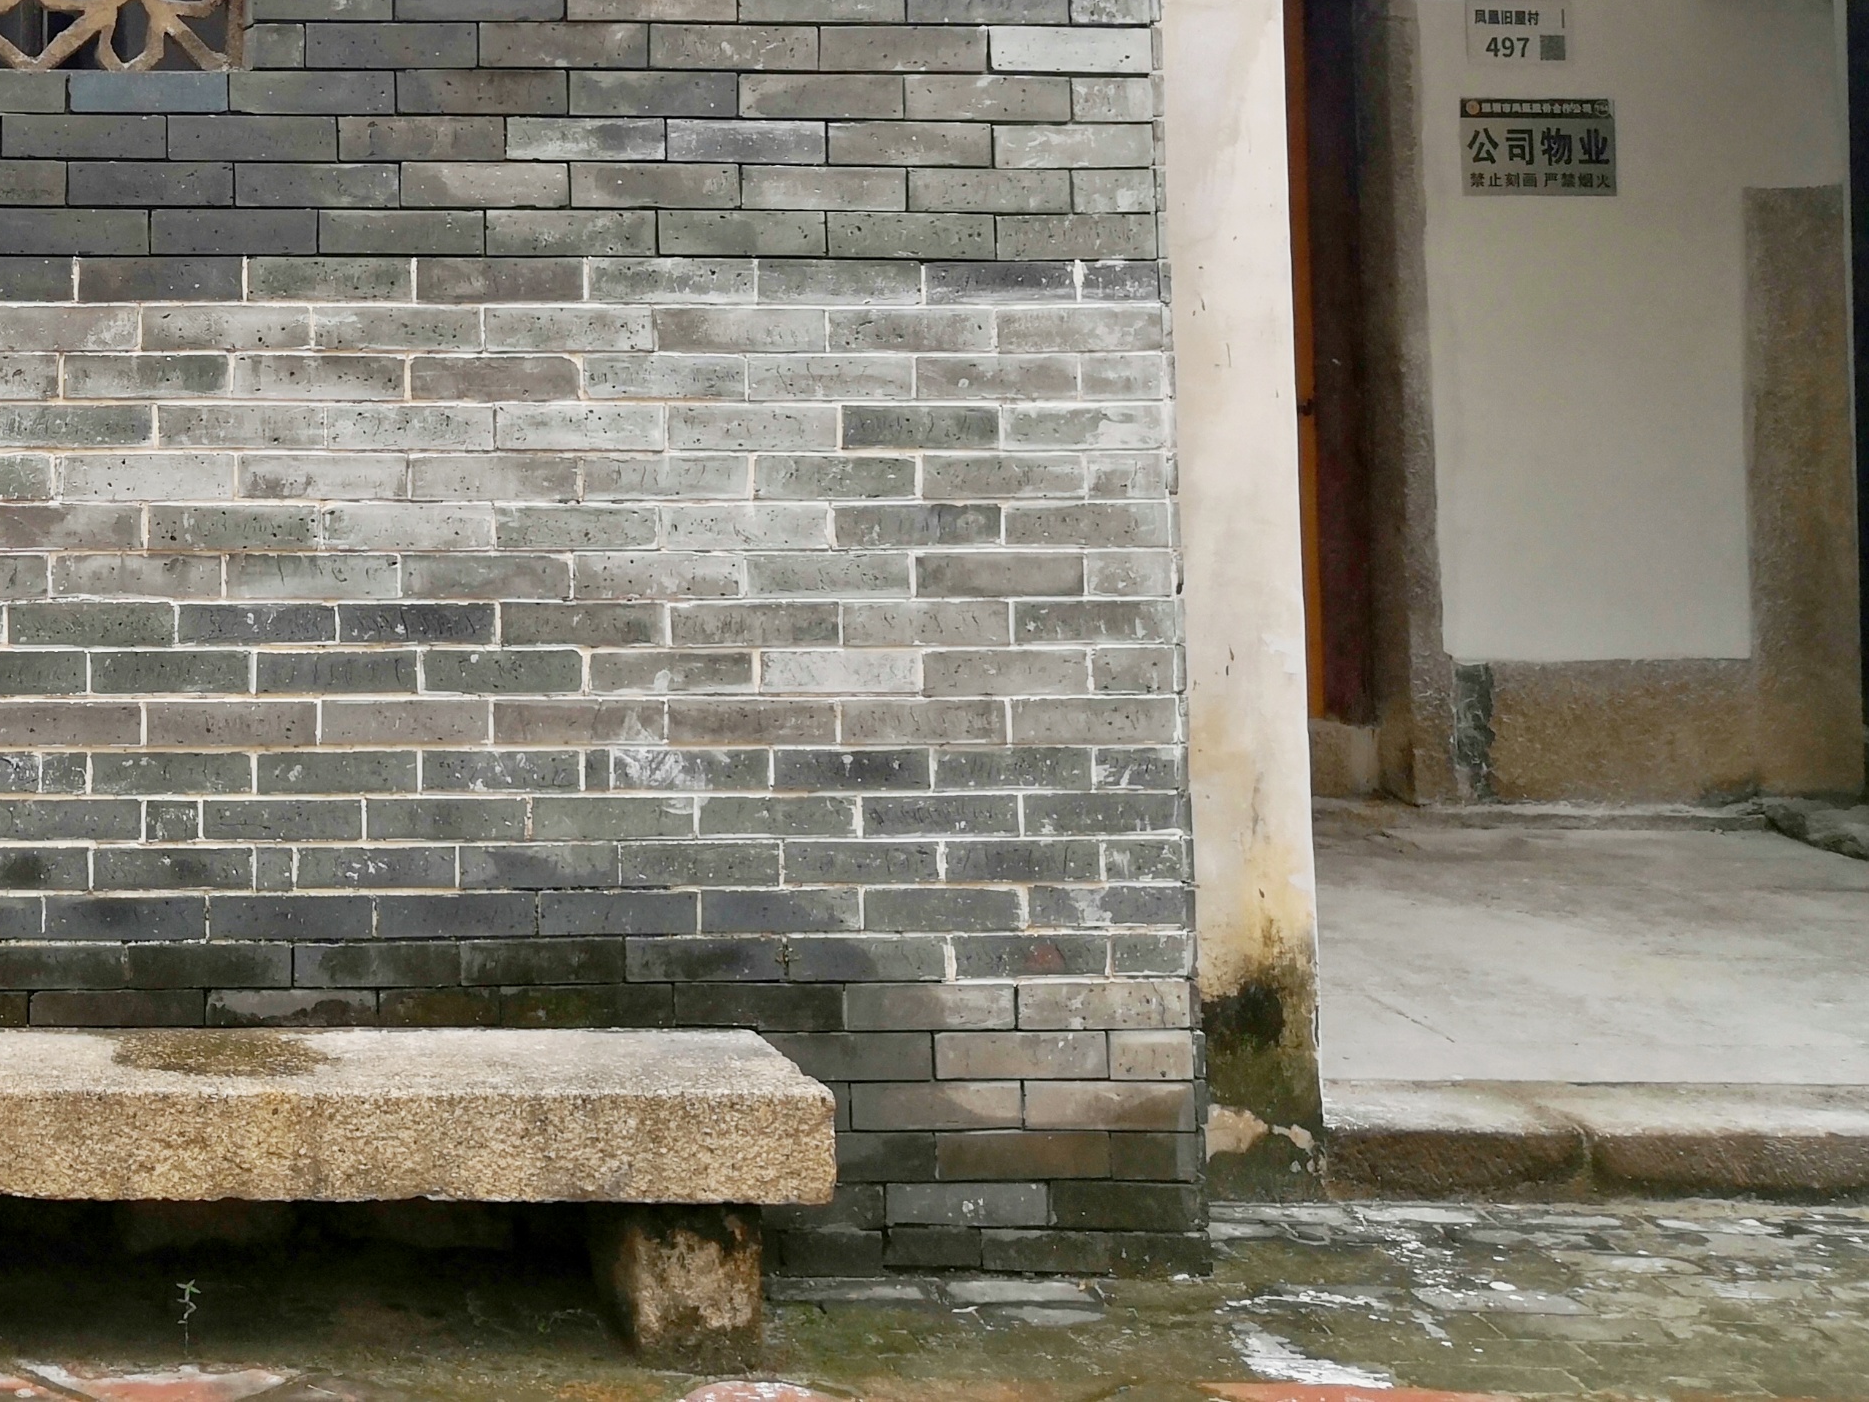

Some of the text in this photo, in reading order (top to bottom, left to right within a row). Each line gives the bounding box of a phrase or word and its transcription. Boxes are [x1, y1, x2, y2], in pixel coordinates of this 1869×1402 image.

[1474, 9, 1540, 26] 凤凰旧屋村
[1485, 36, 1531, 58] 497
[1466, 127, 1611, 166] 公司物业
[1470, 172, 1611, 188] 禁止刻画 严禁烟火
